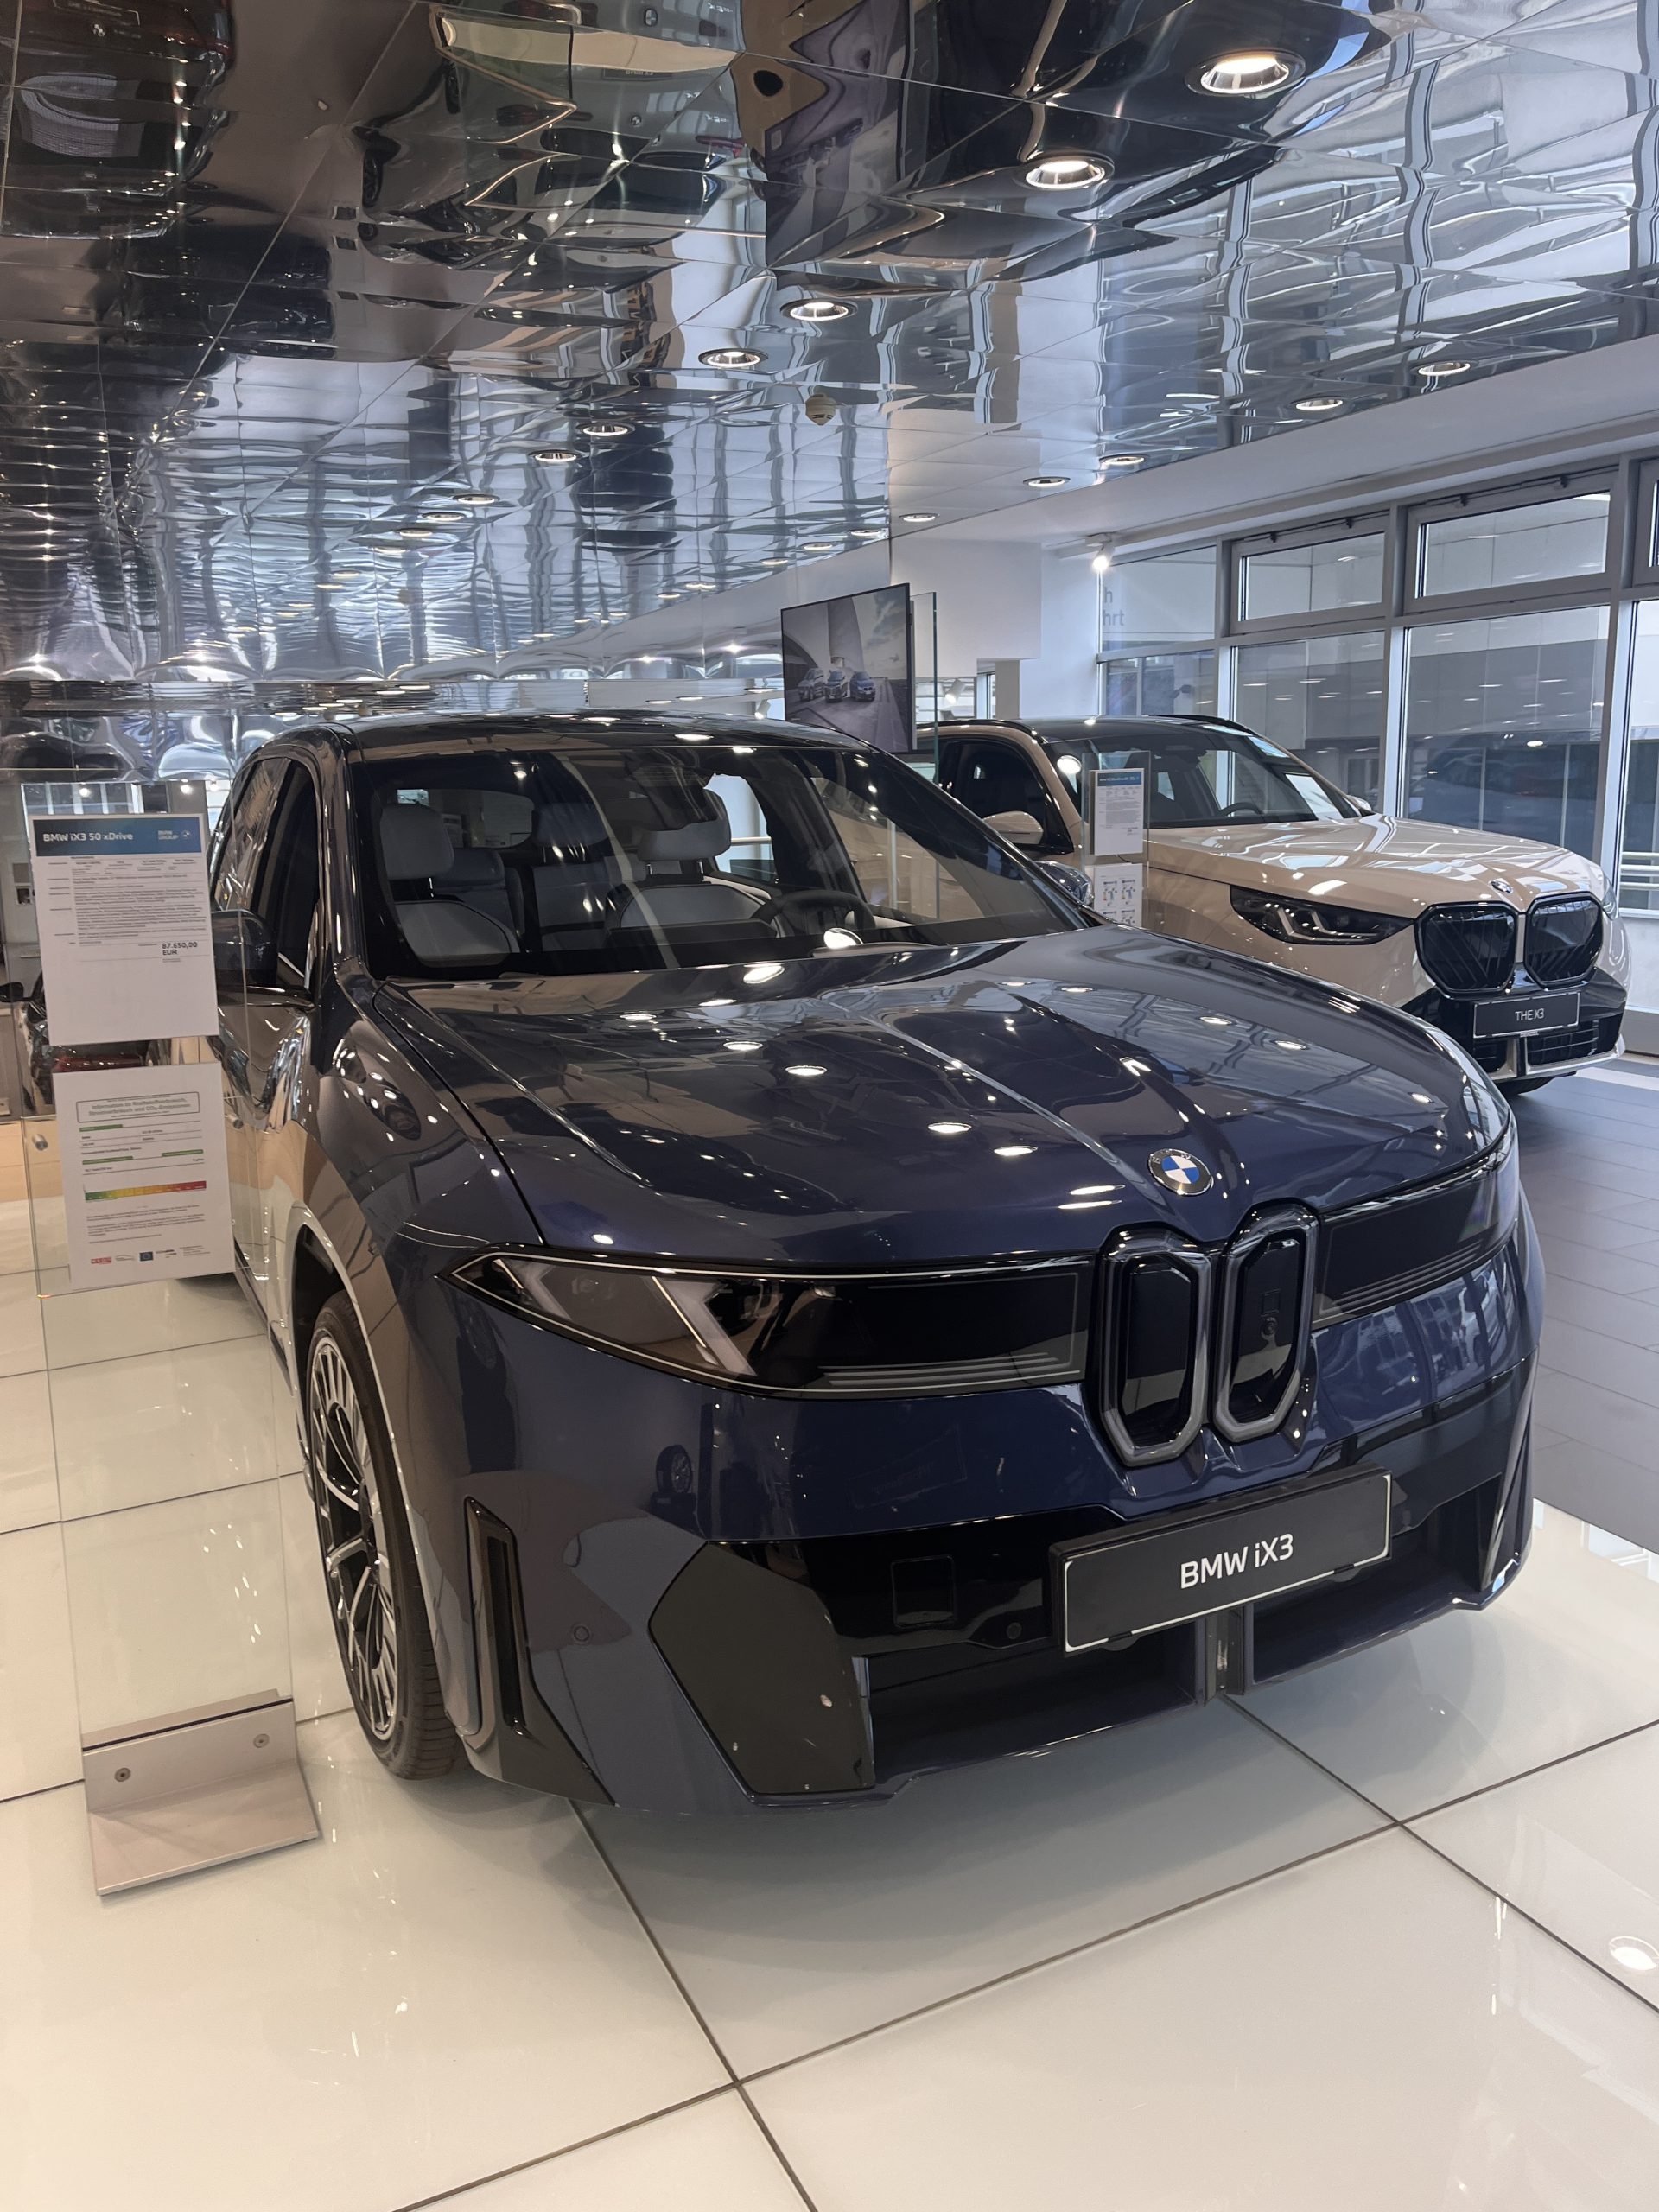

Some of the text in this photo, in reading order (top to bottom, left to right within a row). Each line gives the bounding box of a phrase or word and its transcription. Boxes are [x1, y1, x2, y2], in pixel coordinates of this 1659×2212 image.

[42, 832, 133, 842] BMW iX3 50 xDrive
[162, 941, 198, 950] 87.650,00
[1515, 1007, 1545, 1021] THE X3
[1179, 1533, 1294, 1589] BMW iX3
